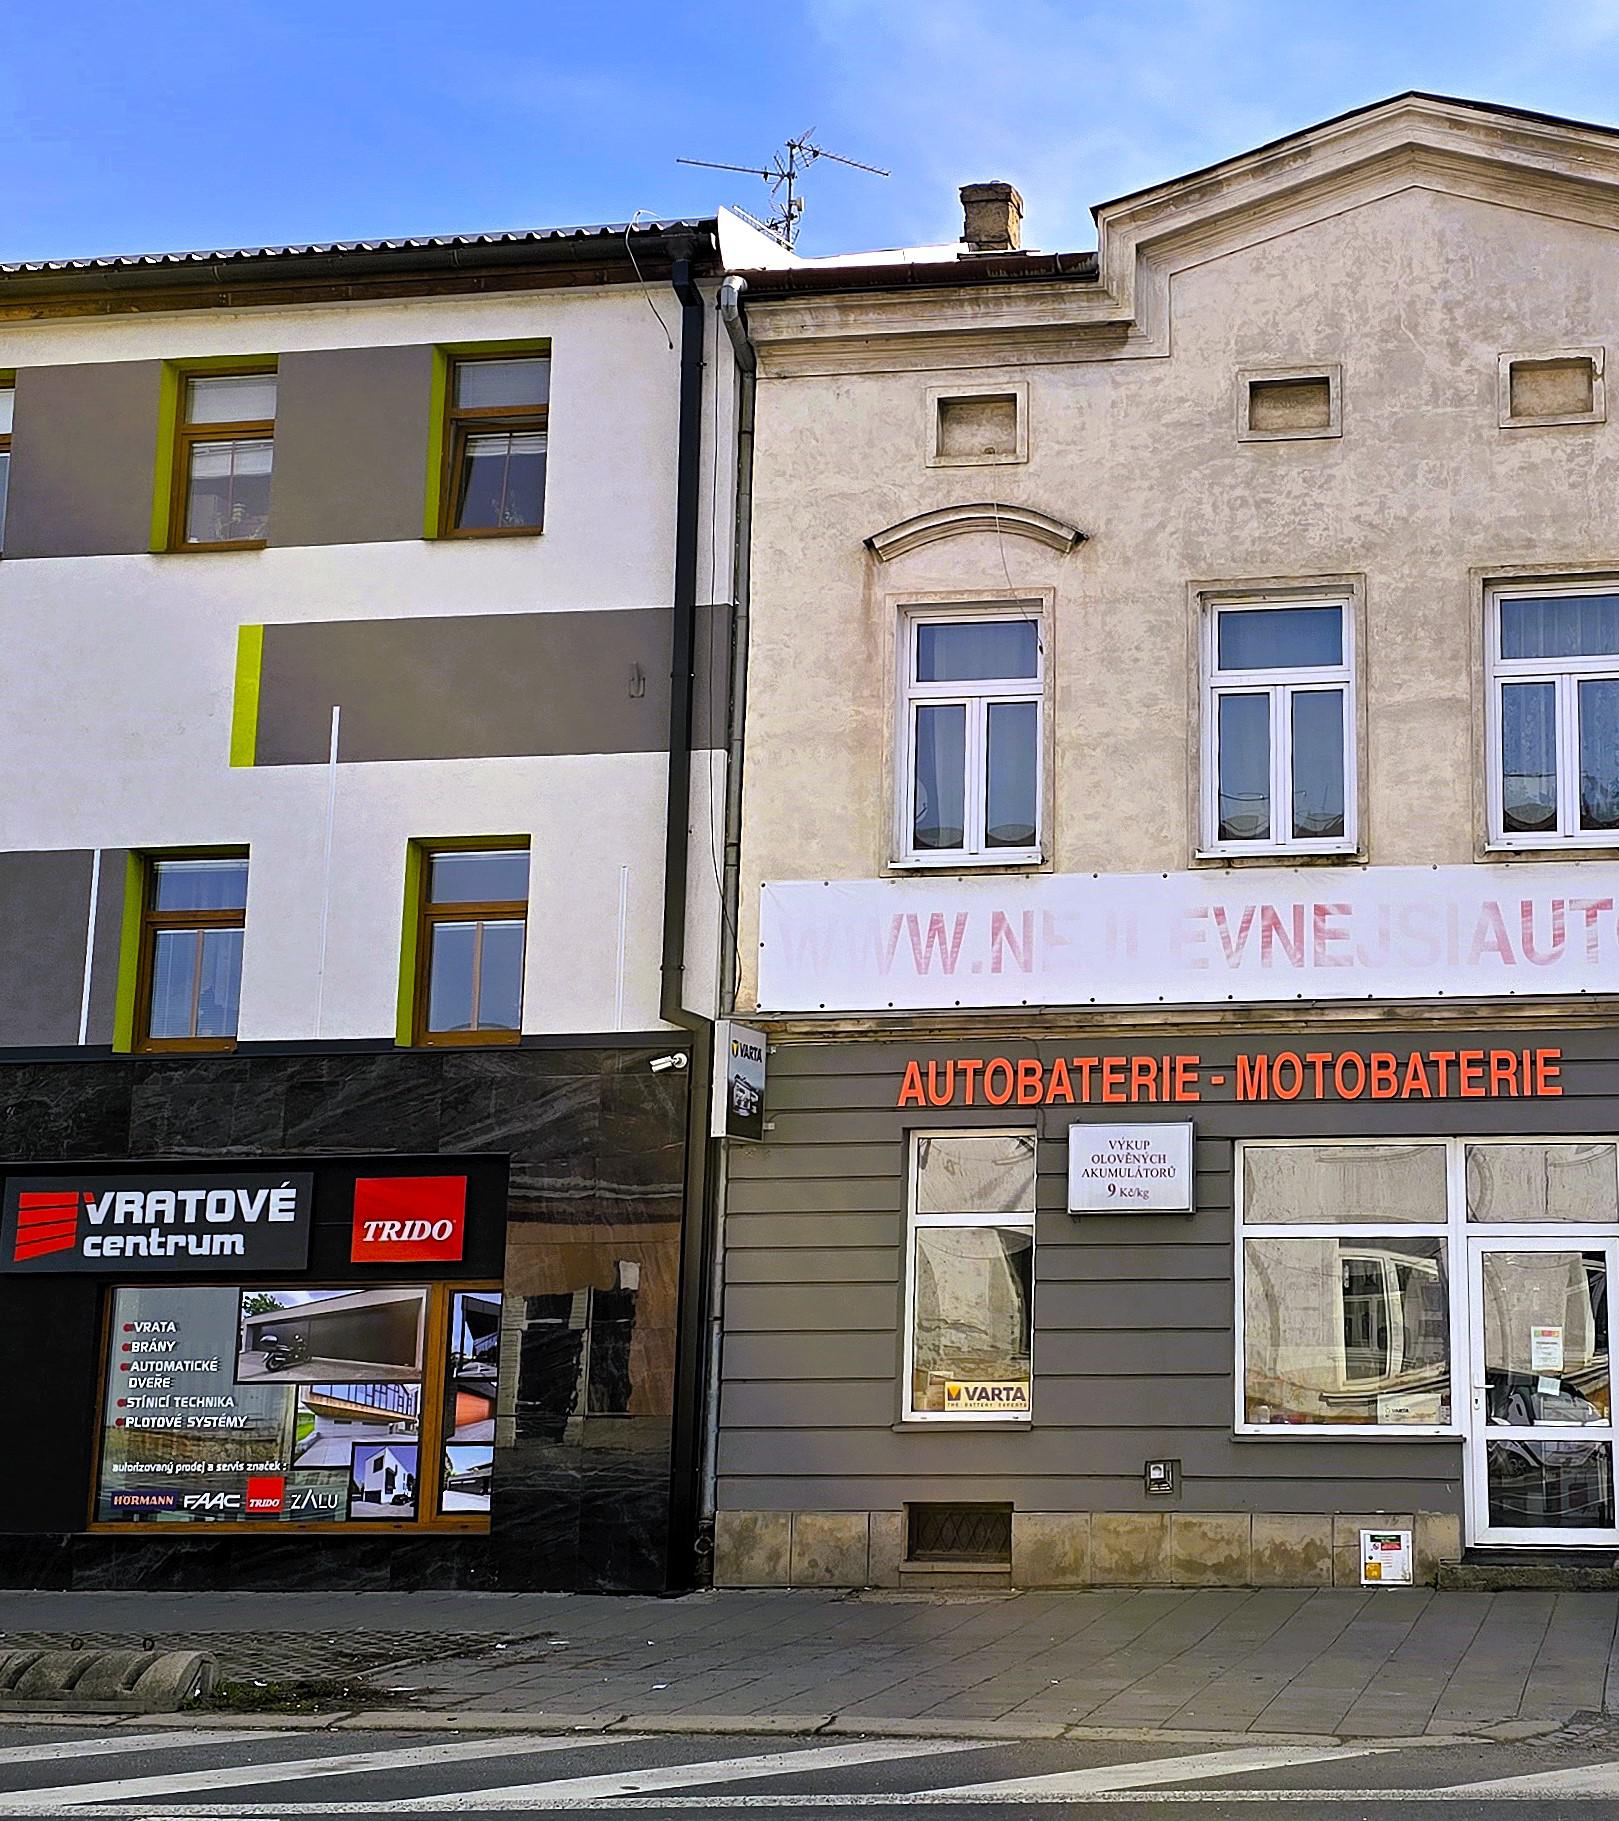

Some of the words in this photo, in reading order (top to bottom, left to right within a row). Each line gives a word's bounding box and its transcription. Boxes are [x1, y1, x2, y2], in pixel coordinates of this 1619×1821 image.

[740, 1042, 762, 1063] VARTA
[897, 1055, 1201, 1106] AUTOBATERIE
[1235, 1048, 1563, 1101] MOTOBATERIE
[1108, 1137, 1150, 1150] VÝKUP
[1091, 1152, 1167, 1165] OLOVĚNÝCH
[1082, 1165, 1176, 1178] AKUMULÁTORŮ
[1107, 1183, 1116, 1198] 9
[1119, 1187, 1149, 1200] Kč/kg
[83, 1181, 297, 1225] VRATOVÉ
[362, 1219, 453, 1242] TRIDO
[83, 1228, 245, 1258] centrum
[134, 1321, 177, 1333] VRATA
[131, 1338, 177, 1353] BRÁNY
[130, 1356, 219, 1372] AUTOMATICKÉ
[128, 1374, 172, 1389] DVEŘE
[964, 1386, 1027, 1401] VARTA
[126, 1395, 170, 1408] STÍNICÍ
[174, 1396, 235, 1408] TECHNIKA
[125, 1413, 182, 1428] PLOTOVÉ
[187, 1413, 248, 1428] SYSTÉMY
[112, 1461, 174, 1474] autorizovaný
[175, 1461, 205, 1474] prodej
[207, 1463, 214, 1472] a
[216, 1461, 245, 1472] servis
[184, 1492, 241, 1509] FAAC
[249, 1498, 280, 1508] TRIDO
